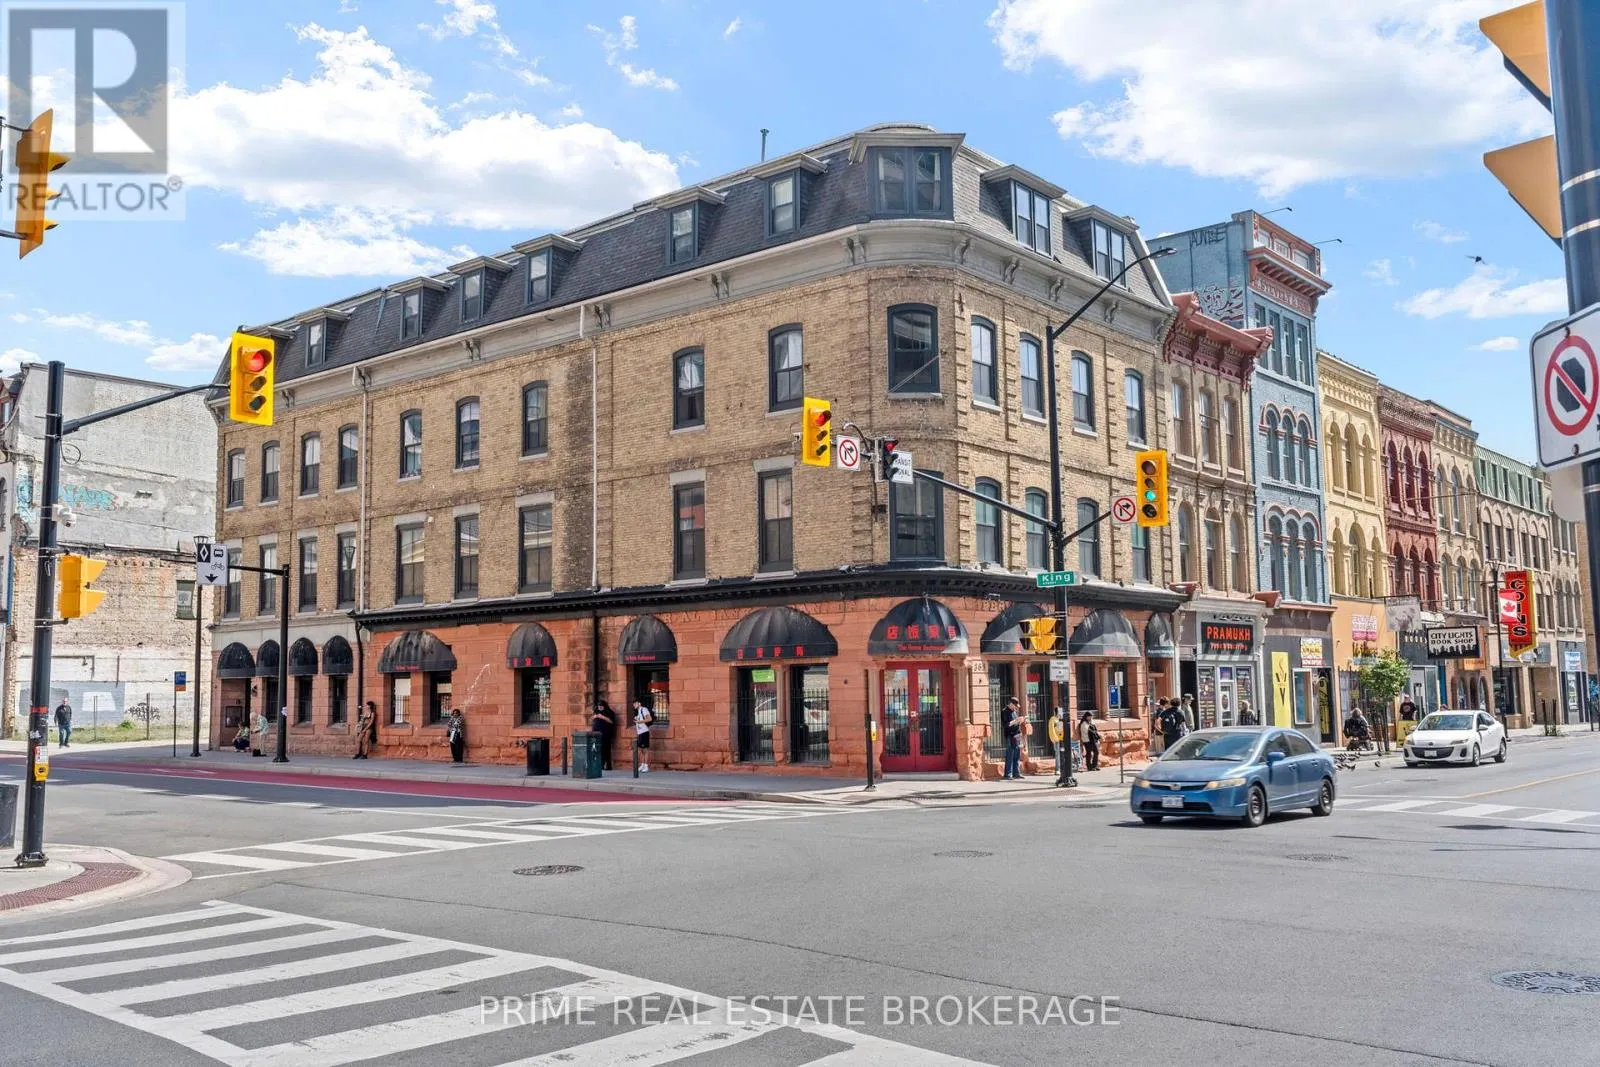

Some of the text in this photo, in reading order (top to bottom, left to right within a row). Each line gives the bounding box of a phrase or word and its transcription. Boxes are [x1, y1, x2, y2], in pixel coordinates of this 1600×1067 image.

[1042, 573, 1071, 582] King
[1206, 626, 1251, 641] PRAMUKH
[1430, 631, 1474, 640] CITY LIGHTS
